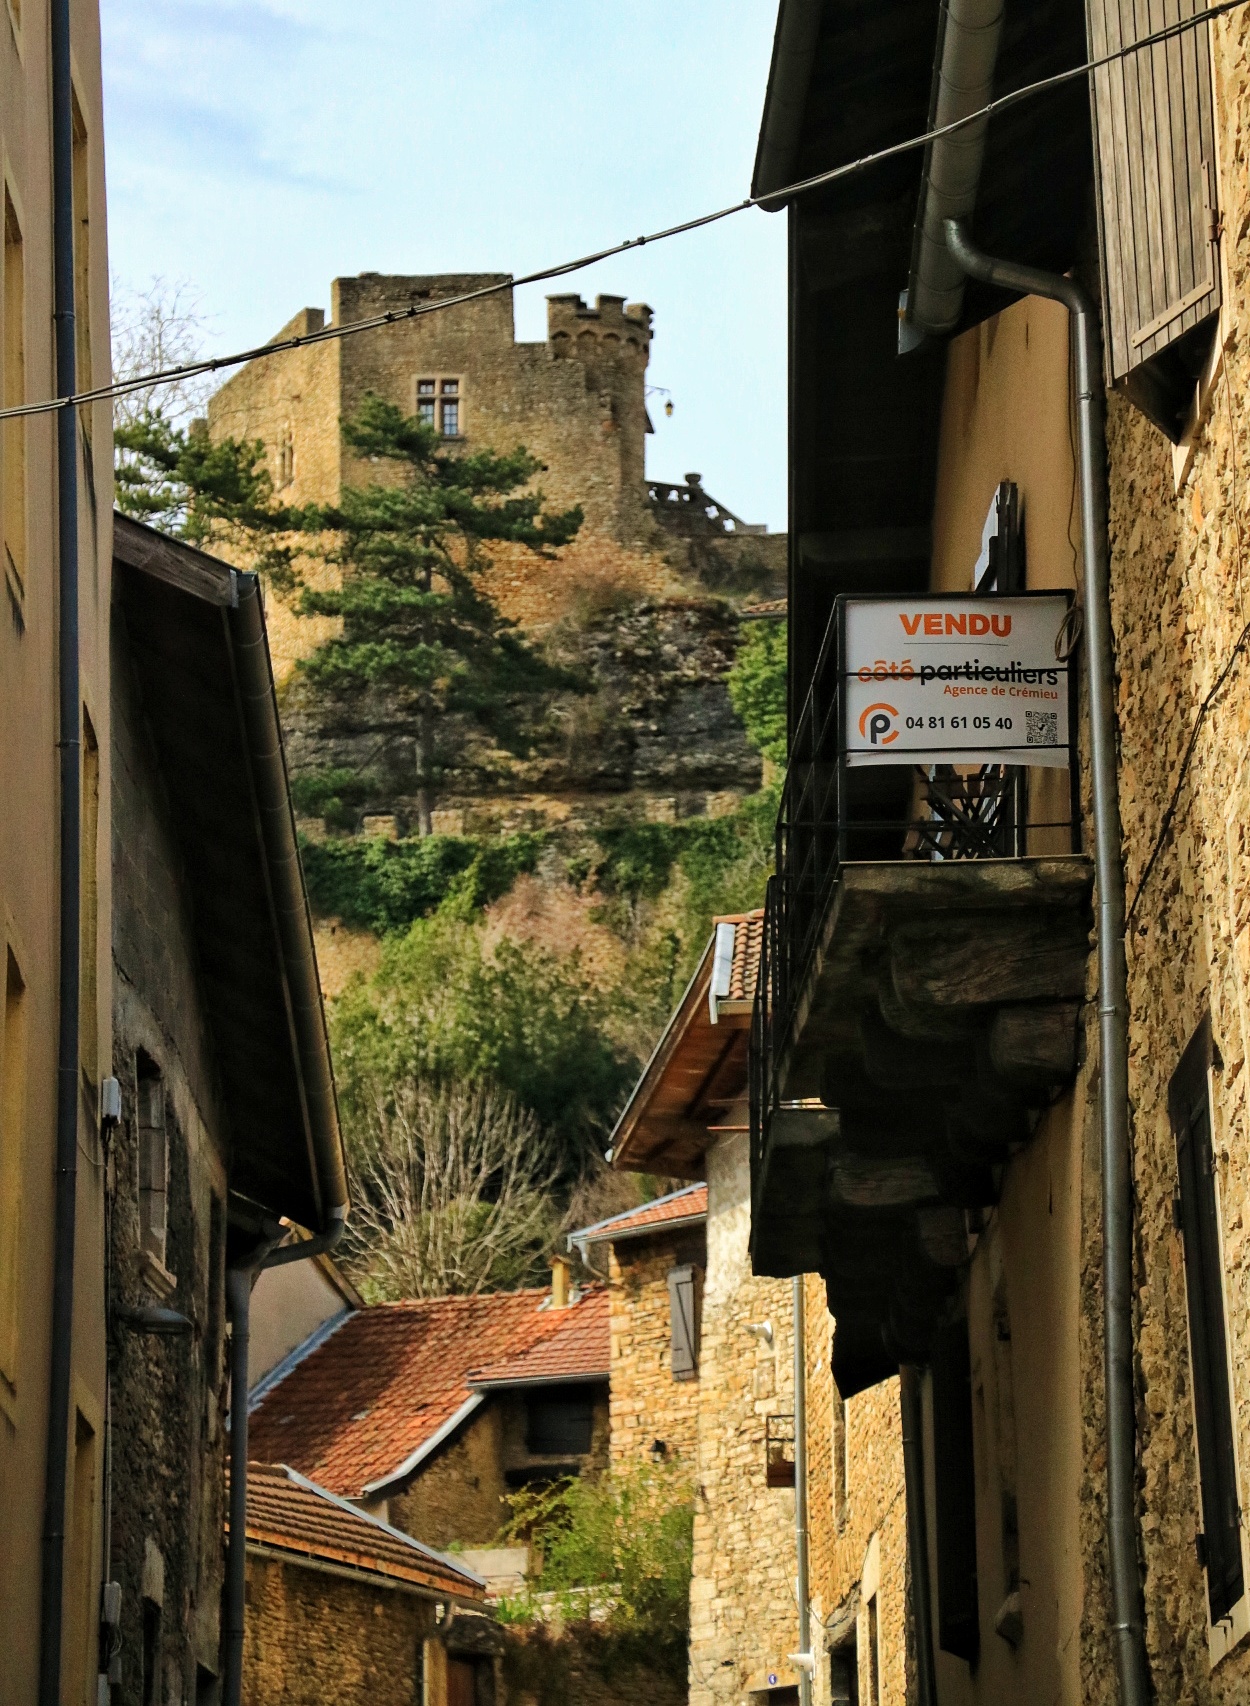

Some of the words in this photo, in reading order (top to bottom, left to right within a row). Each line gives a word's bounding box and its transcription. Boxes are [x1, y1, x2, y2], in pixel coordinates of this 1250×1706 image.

[899, 613, 1012, 637] VENDU
[858, 659, 915, 682] côté
[920, 658, 1058, 685] particuliers
[943, 685, 988, 697] Agence
[991, 686, 1006, 696] de
[1009, 687, 1058, 699] Crémieu
[905, 716, 924, 729] 04
[928, 716, 945, 729] 81
[950, 716, 967, 729] 61
[973, 716, 991, 729] 05
[995, 717, 1013, 730] 40
